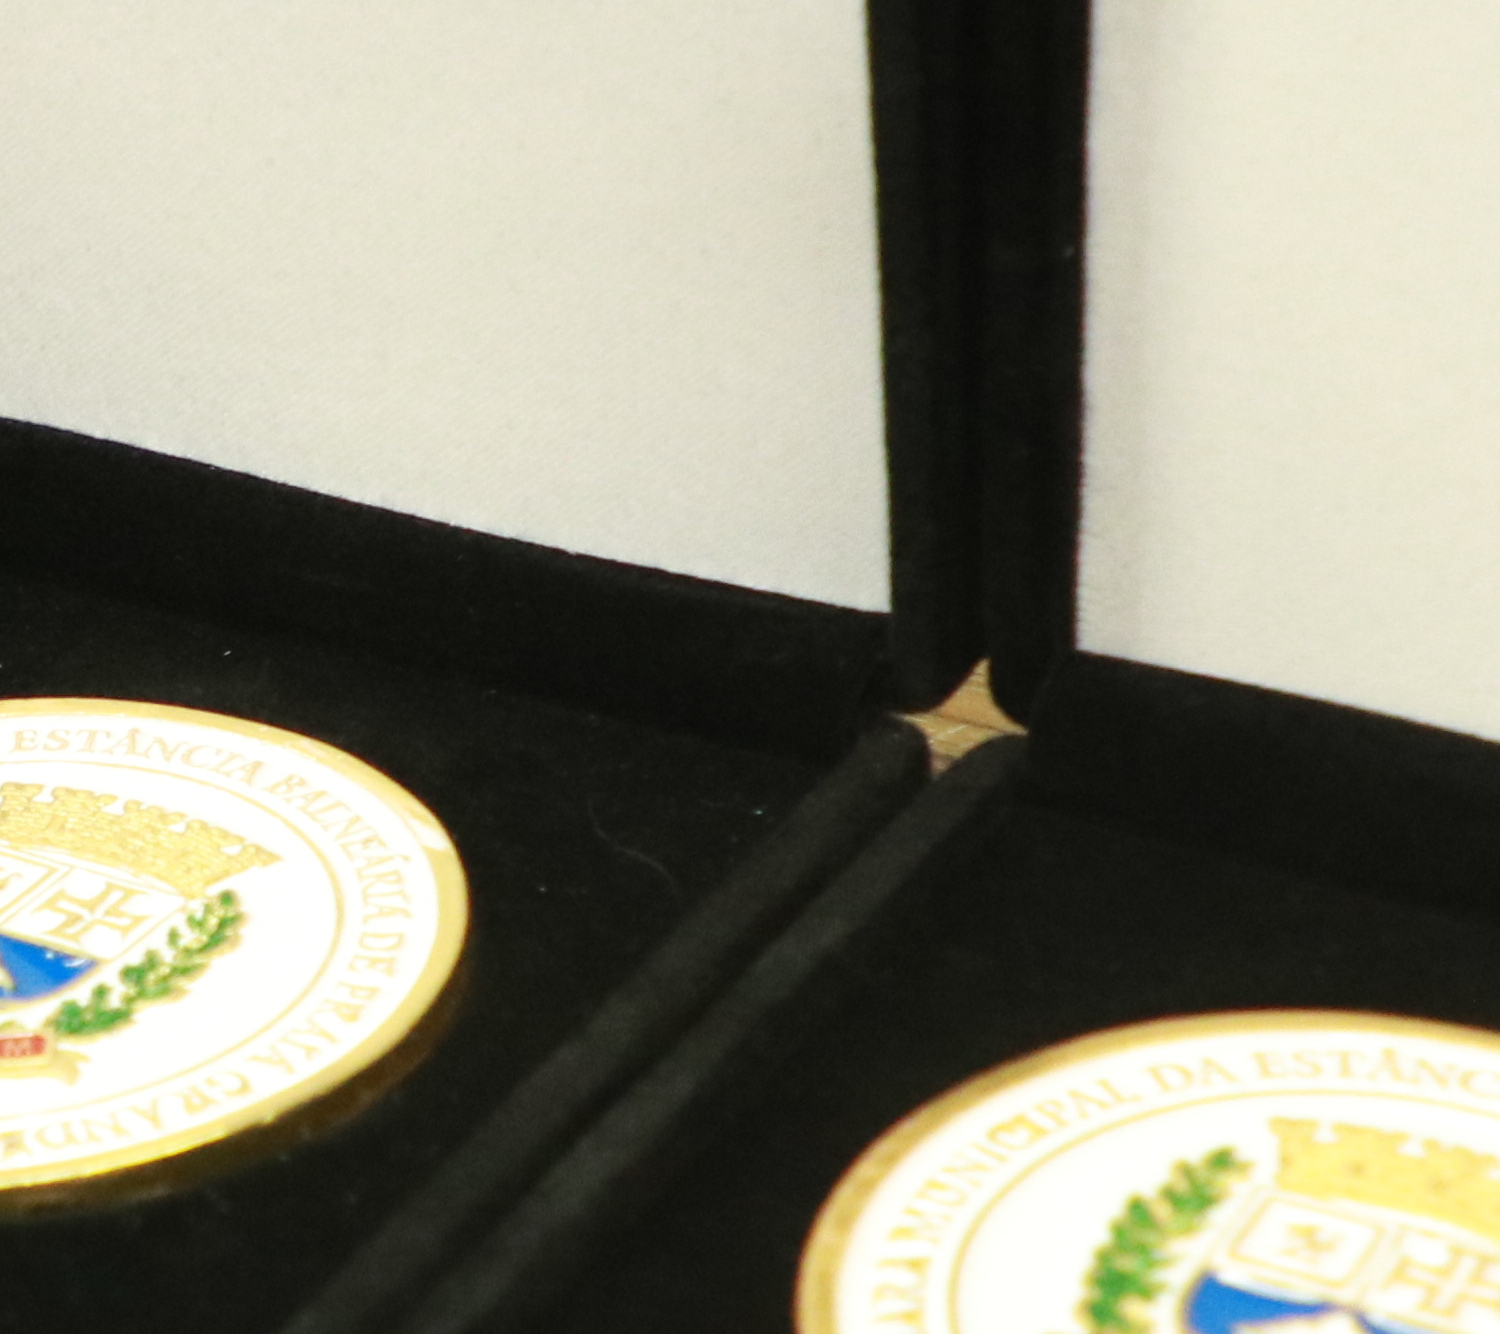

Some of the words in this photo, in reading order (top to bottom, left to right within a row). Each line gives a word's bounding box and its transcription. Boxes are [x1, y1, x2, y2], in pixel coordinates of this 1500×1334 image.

[8, 726, 265, 788] ESTÂNCIA
[262, 773, 413, 927] BALNEÁRIA
[347, 930, 407, 978] DE
[1146, 1055, 1243, 1096] DA
